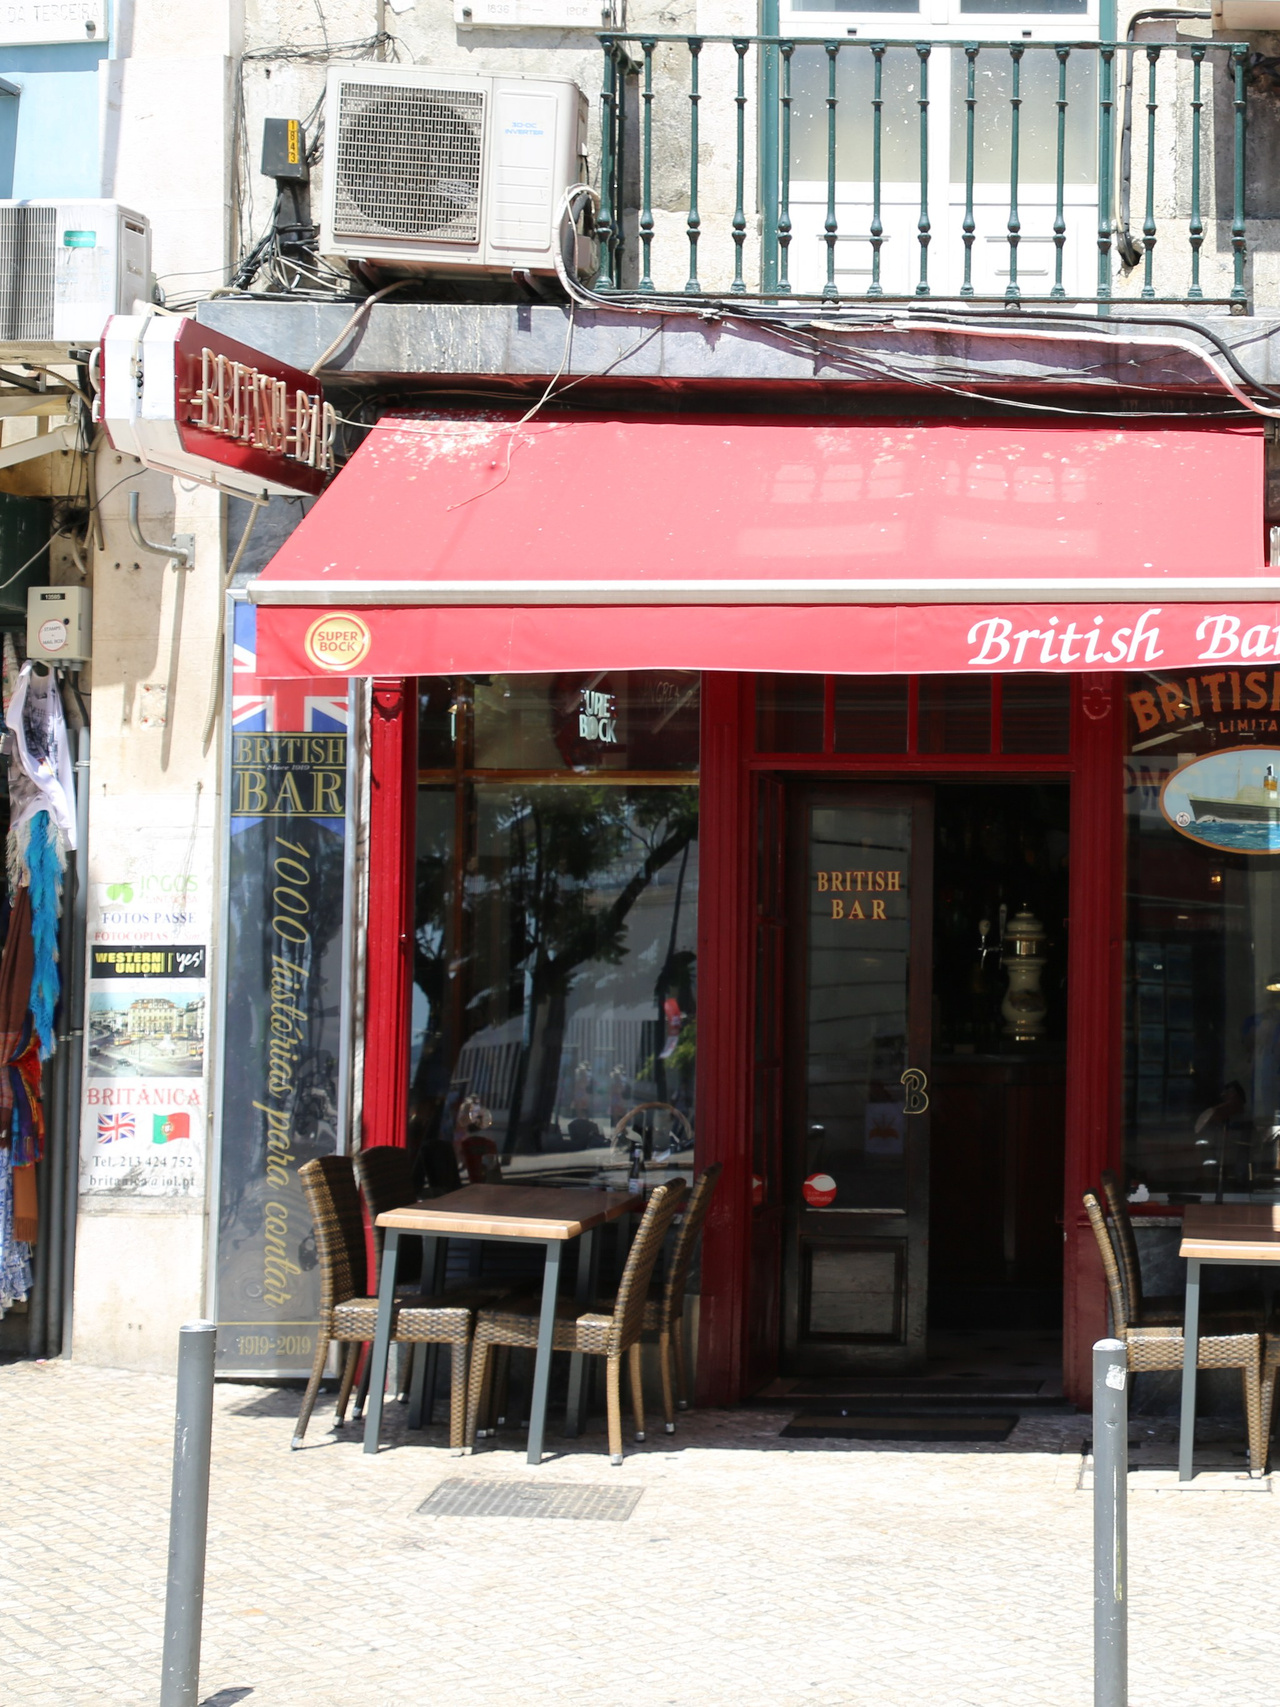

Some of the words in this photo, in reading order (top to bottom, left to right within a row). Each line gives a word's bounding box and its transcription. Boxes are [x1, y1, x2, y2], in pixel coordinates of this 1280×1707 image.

[504, 128, 545, 136] INVERTER
[295, 389, 337, 474] BAR
[317, 631, 358, 641] SUPER
[319, 642, 355, 652] BOCK
[966, 608, 1164, 666] British
[579, 713, 617, 743] BOCK
[235, 737, 346, 764] BRITISH
[234, 770, 343, 813] BAR
[271, 836, 311, 943] 1000
[817, 870, 901, 892] BRITISH
[103, 912, 150, 925] FOTOS
[154, 912, 197, 925] PASSE
[831, 898, 887, 920] BAR
[95, 952, 162, 963] WESTERN
[115, 963, 162, 973] UNION
[266, 953, 309, 1099] histórias
[86, 1083, 202, 1106] BRITÂNICA
[900, 1067, 929, 1114] B
[251, 1100, 296, 1190] para
[120, 1155, 141, 1168] 213
[144, 1155, 167, 1168] 424
[171, 1155, 193, 1168] 752
[262, 1201, 301, 1309] contar
[238, 1334, 311, 1357] 1919-2019
